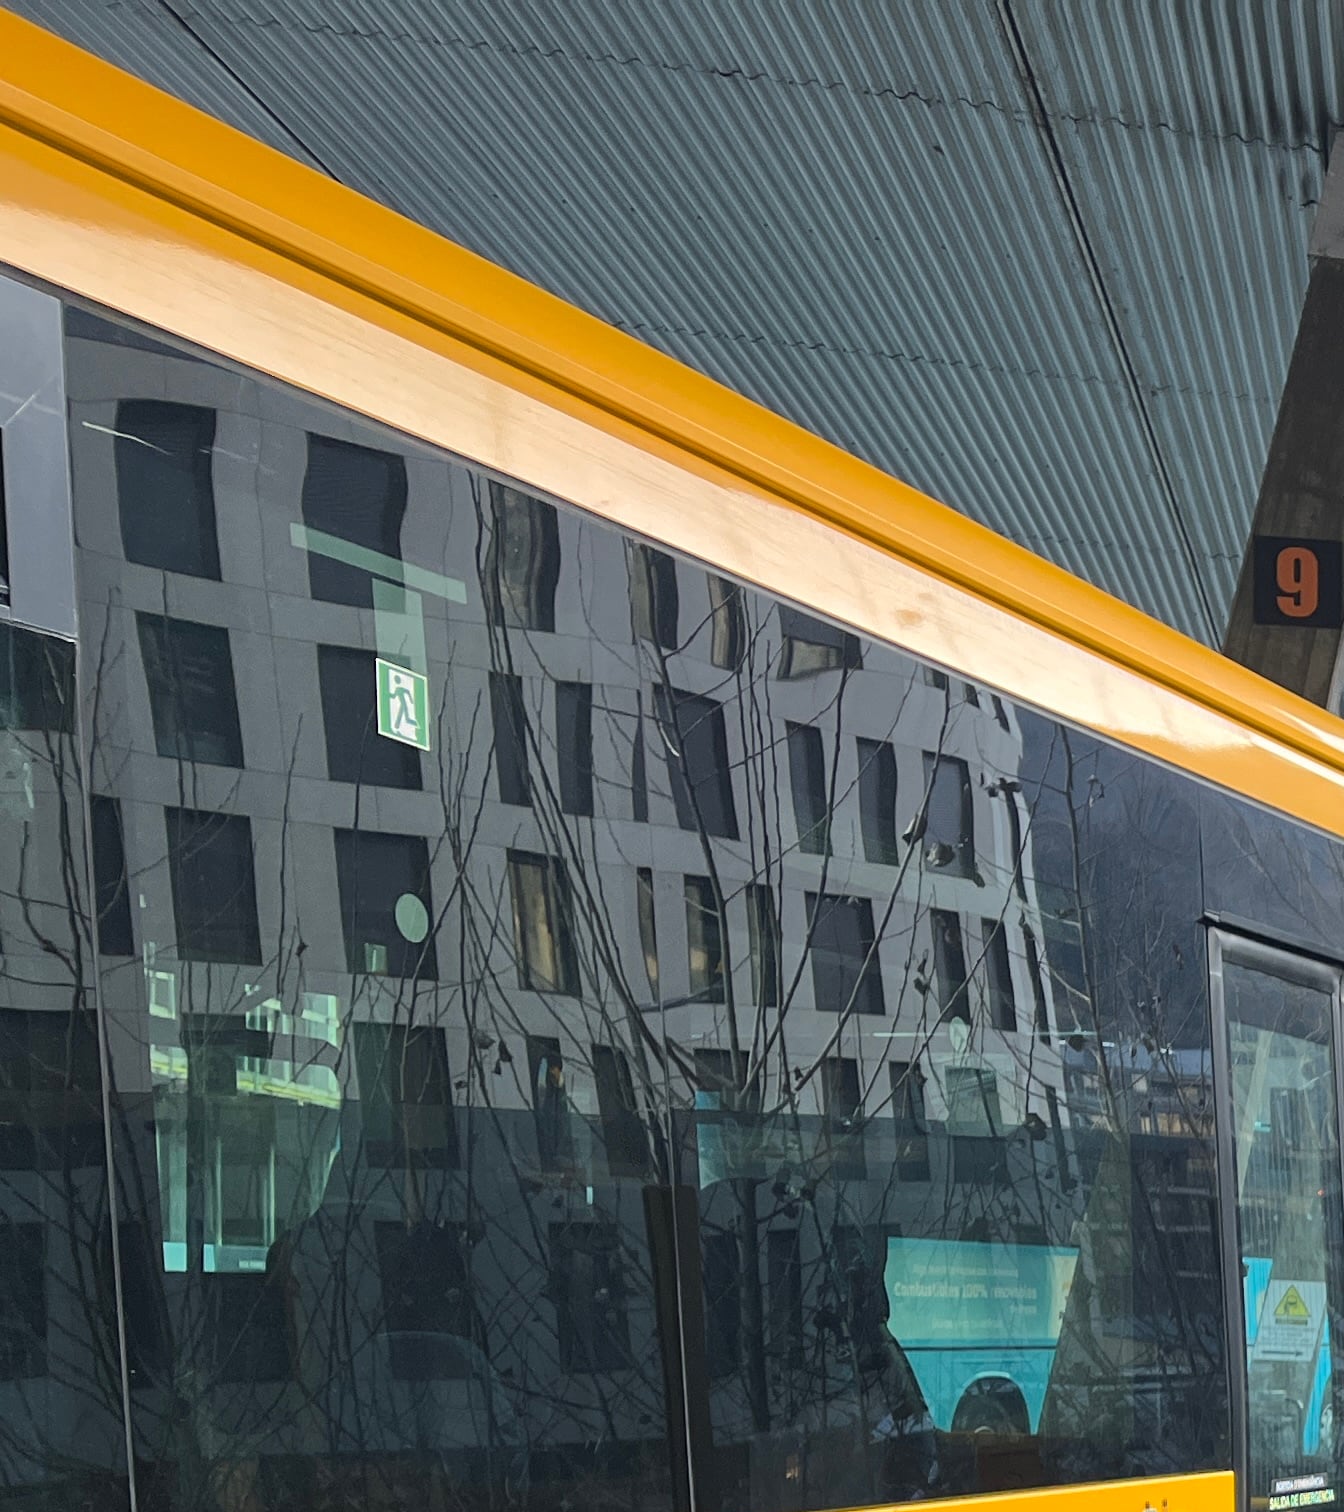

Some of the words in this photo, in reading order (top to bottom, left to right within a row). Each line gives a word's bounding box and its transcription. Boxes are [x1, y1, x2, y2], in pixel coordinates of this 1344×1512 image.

[1275, 546, 1320, 619] 9
[1269, 1495, 1290, 1511] SALIDA
[1290, 1493, 1299, 1508] DE
